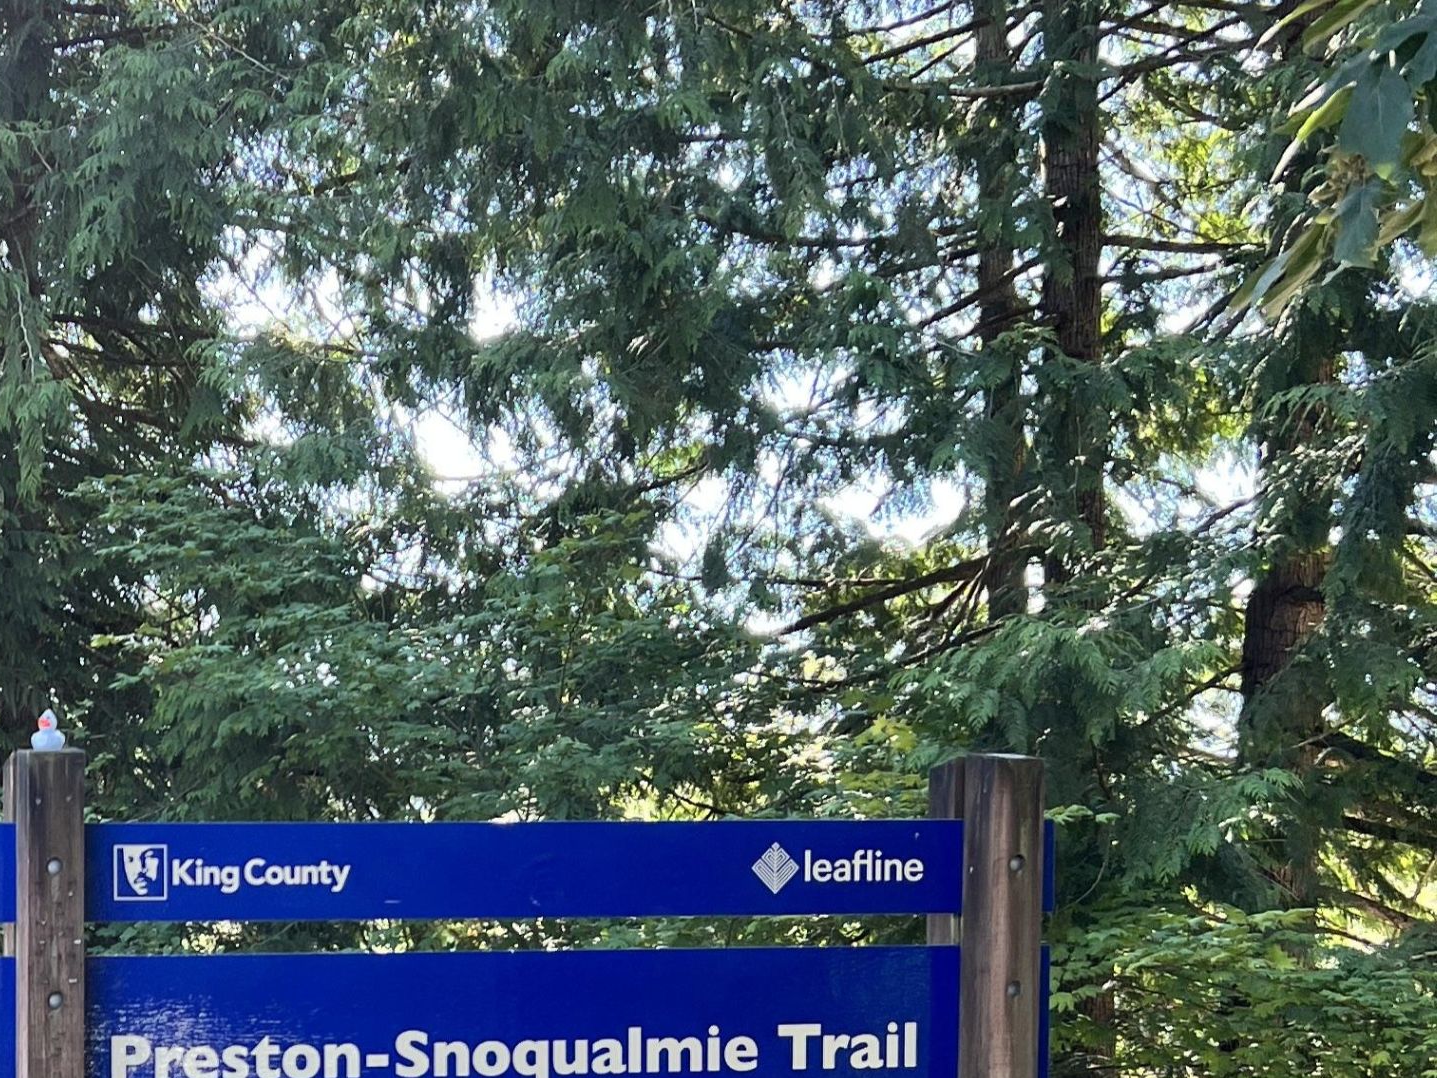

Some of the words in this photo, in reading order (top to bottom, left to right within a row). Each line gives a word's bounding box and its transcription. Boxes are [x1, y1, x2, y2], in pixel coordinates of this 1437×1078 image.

[172, 858, 240, 894] King
[244, 858, 351, 893] County
[804, 849, 924, 882] leafline
[778, 1022, 919, 1072] Trail
